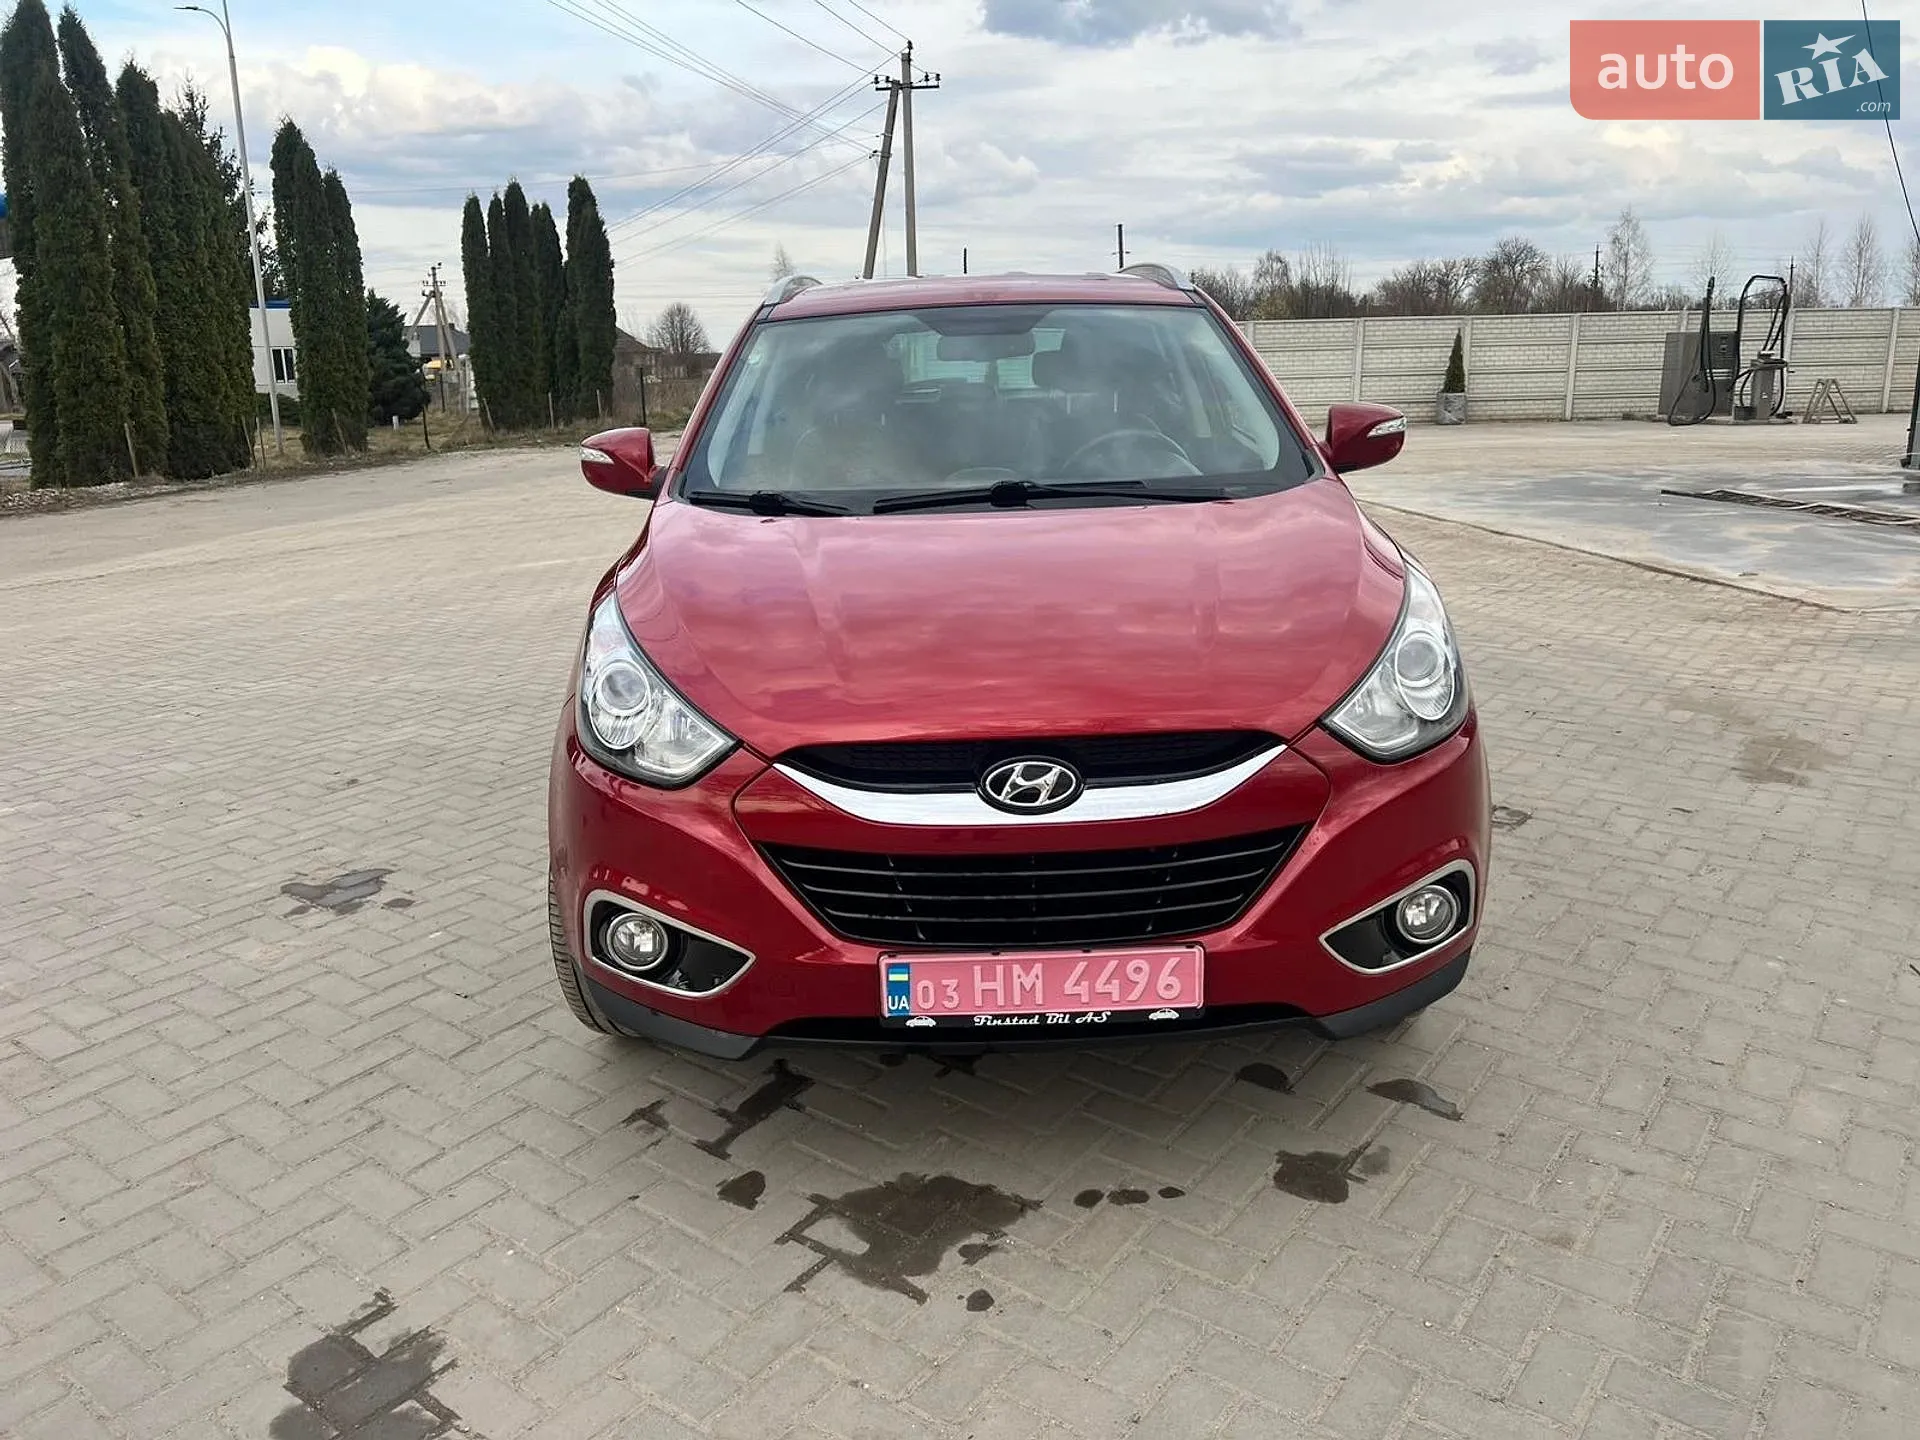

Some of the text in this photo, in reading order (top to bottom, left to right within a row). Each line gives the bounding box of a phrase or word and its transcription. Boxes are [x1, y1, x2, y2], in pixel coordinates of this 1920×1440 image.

[888, 957, 1182, 1011] UA 03 HM 4496
[1046, 1012, 1070, 1025] Bil
